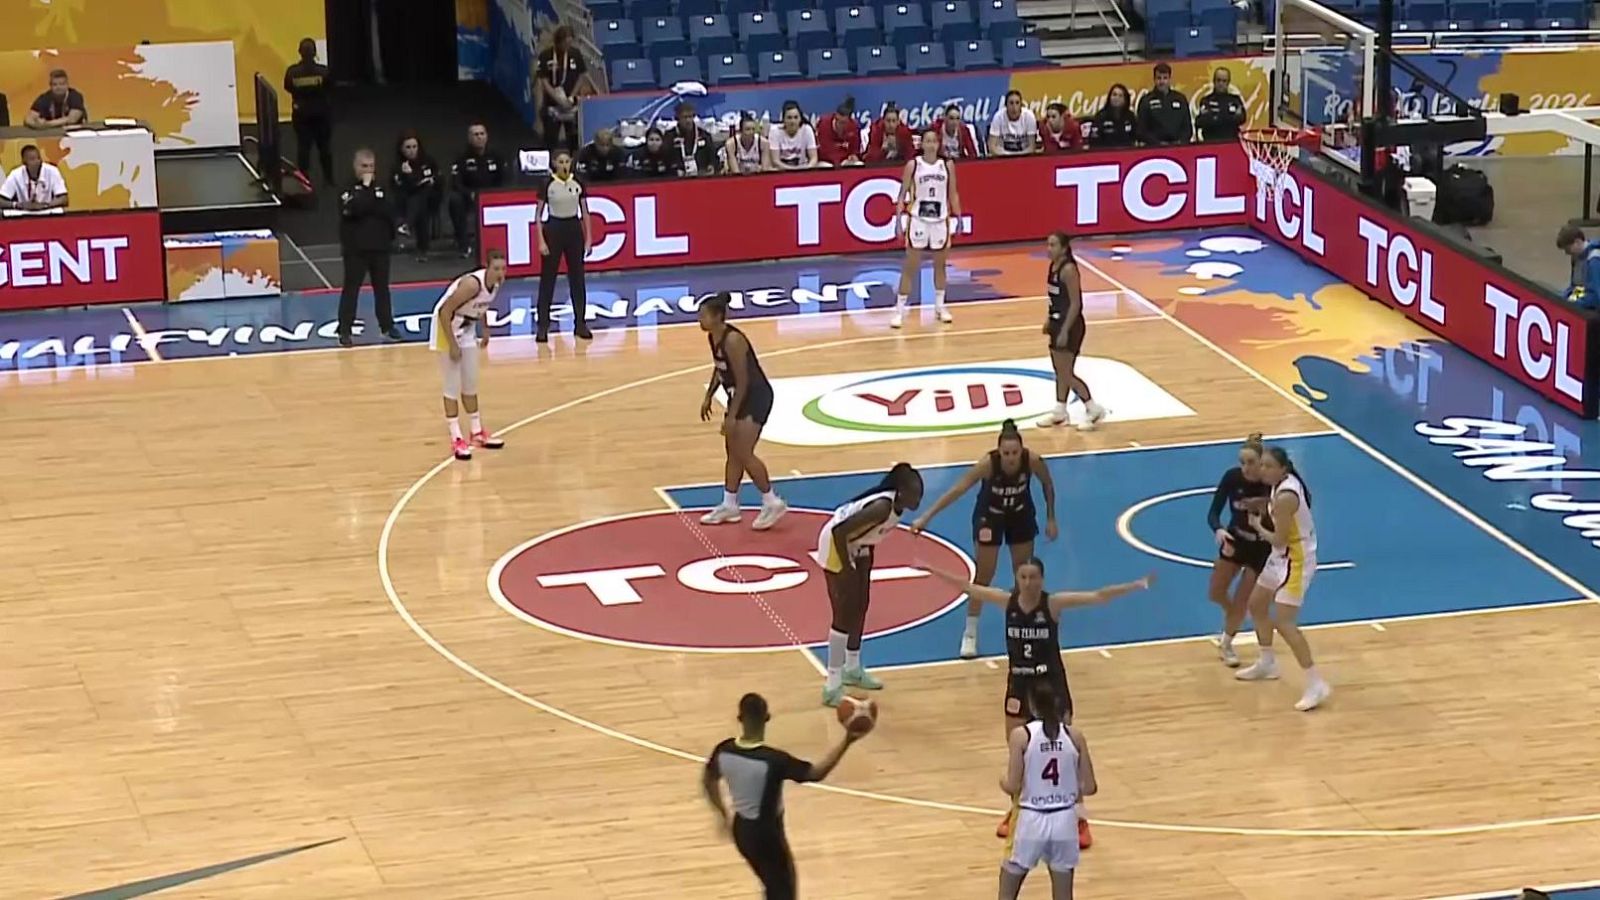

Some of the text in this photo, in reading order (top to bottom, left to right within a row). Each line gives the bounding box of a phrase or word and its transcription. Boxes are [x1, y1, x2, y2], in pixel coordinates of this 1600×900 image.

[775, 177, 972, 245] TC
[1057, 158, 1245, 225] TCL
[1250, 160, 1325, 256] TCL
[483, 195, 688, 266] TCL
[0, 236, 128, 287] ENT
[1359, 217, 1446, 325] TCL
[394, 280, 884, 333] TURNAMENT
[1485, 284, 1582, 402] TCL
[853, 384, 1023, 416] Yili
[1008, 627, 1049, 639] NEW ZEALAND
[1024, 643, 1032, 658] 2
[1041, 757, 1059, 786] 4
